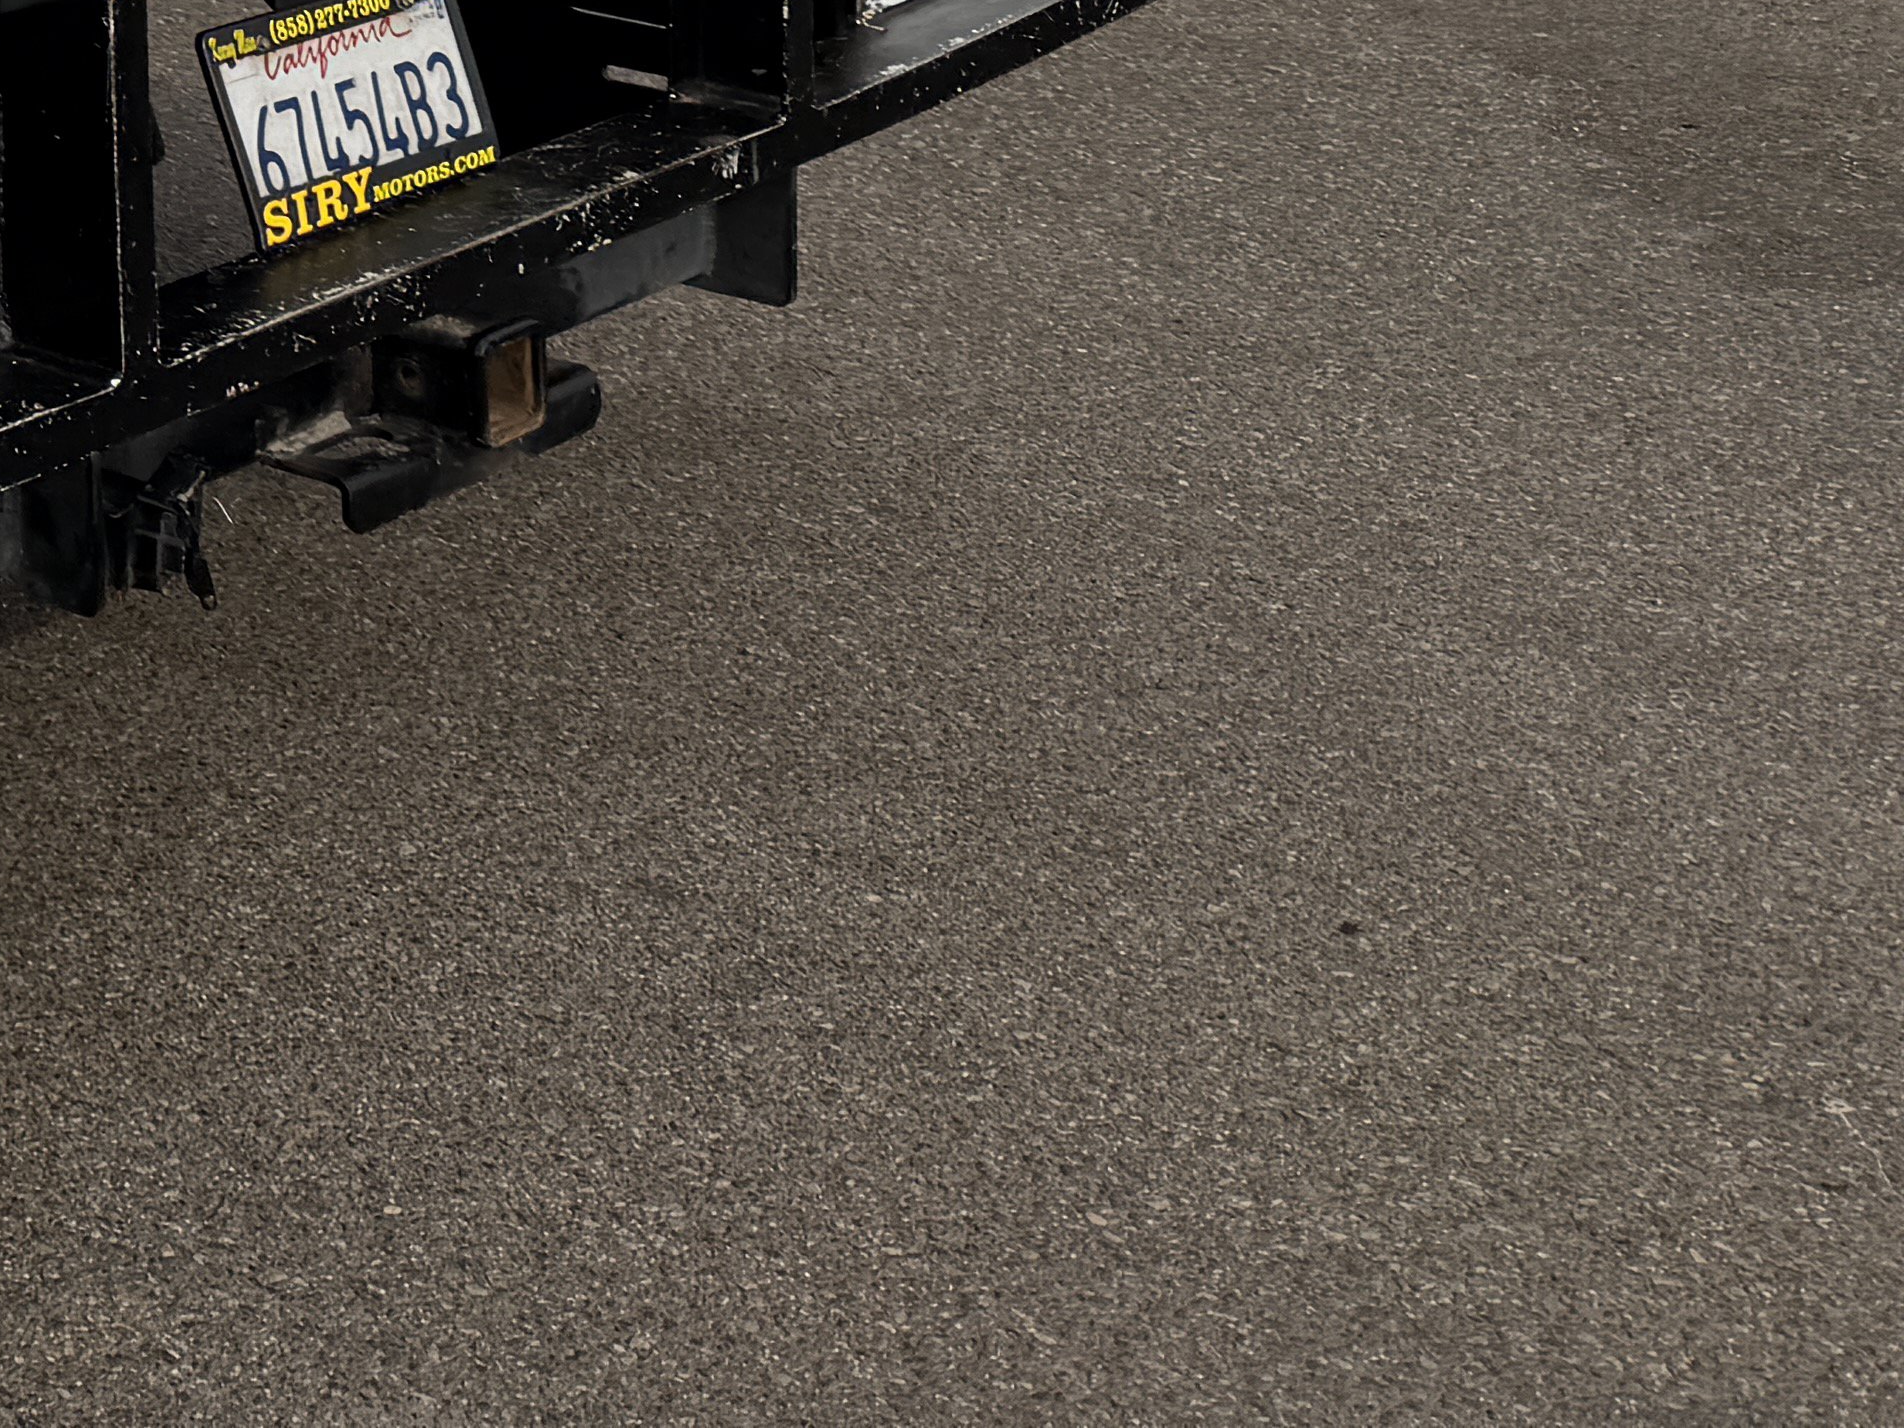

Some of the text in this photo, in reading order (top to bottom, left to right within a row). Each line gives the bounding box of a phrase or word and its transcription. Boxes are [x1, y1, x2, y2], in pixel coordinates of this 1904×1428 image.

[264, 15, 413, 79] California
[257, 51, 472, 197] 67454B3
[262, 145, 497, 247] SIRY MOTORS.COM
